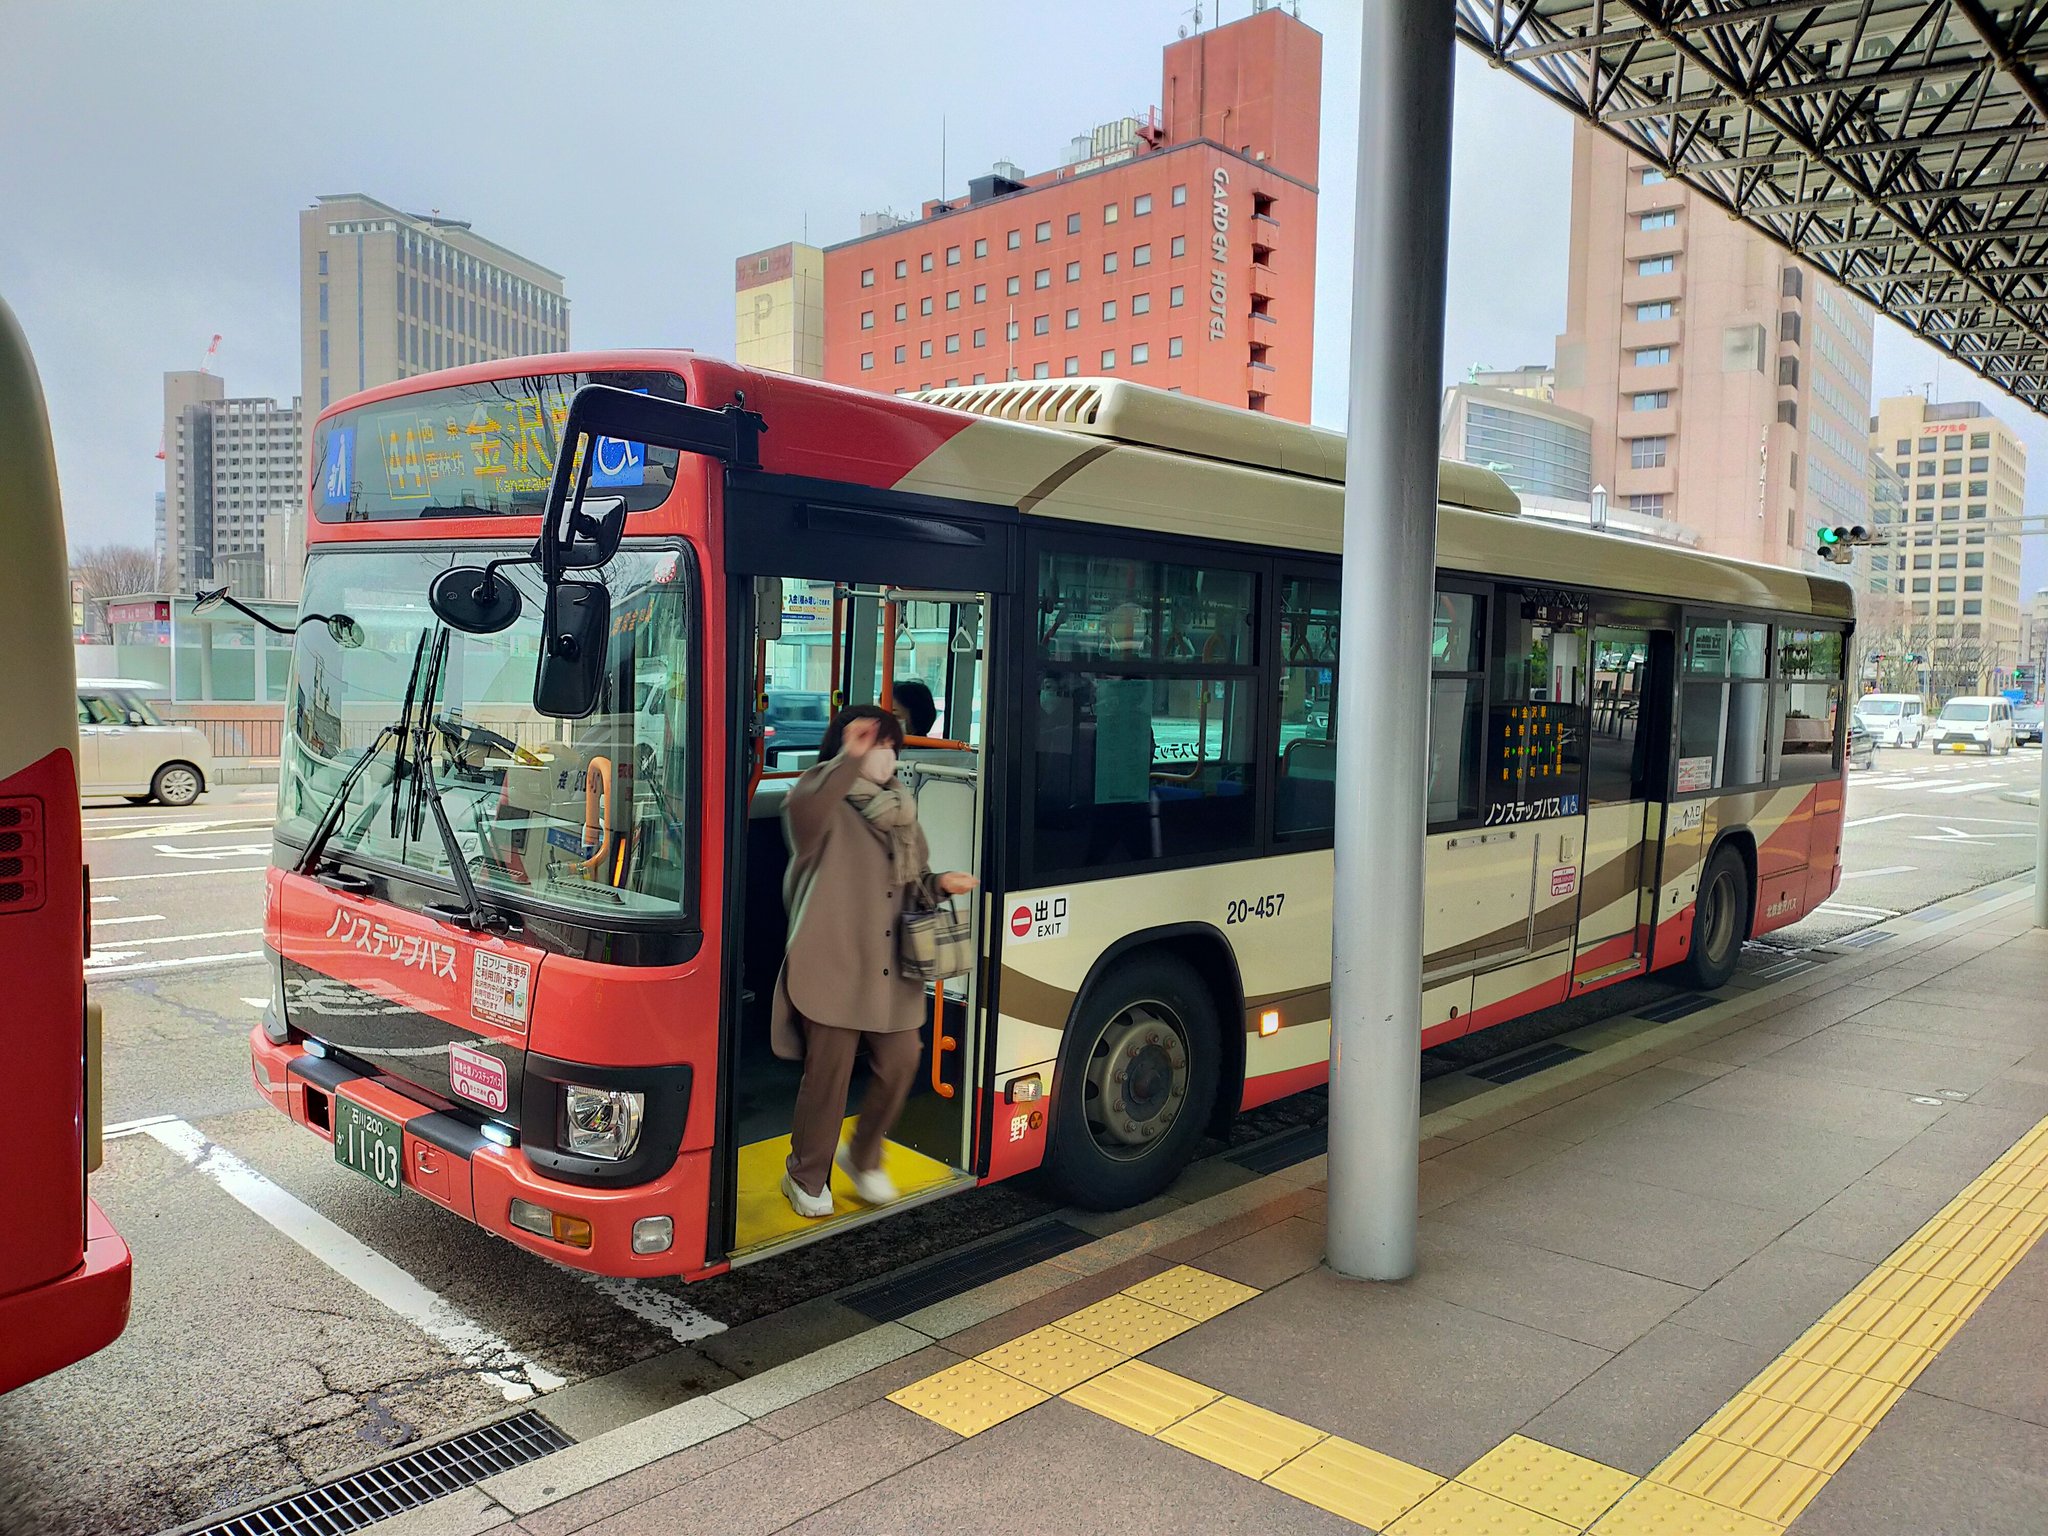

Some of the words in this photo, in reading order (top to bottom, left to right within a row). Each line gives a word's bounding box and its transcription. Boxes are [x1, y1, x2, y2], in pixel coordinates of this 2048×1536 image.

[1212, 167, 1229, 263] GARDEN
[754, 293, 773, 335] P
[1209, 268, 1227, 342] HOTEL
[389, 428, 422, 489] 44
[1484, 797, 1560, 826] ノンステップバス
[1035, 898, 1067, 922] 出口
[1037, 922, 1062, 938] EXIT
[1226, 893, 1285, 925] 20-457
[326, 907, 457, 983] ノンステップバス
[1009, 1114, 1028, 1143] 野
[348, 1123, 397, 1189] 11-03
